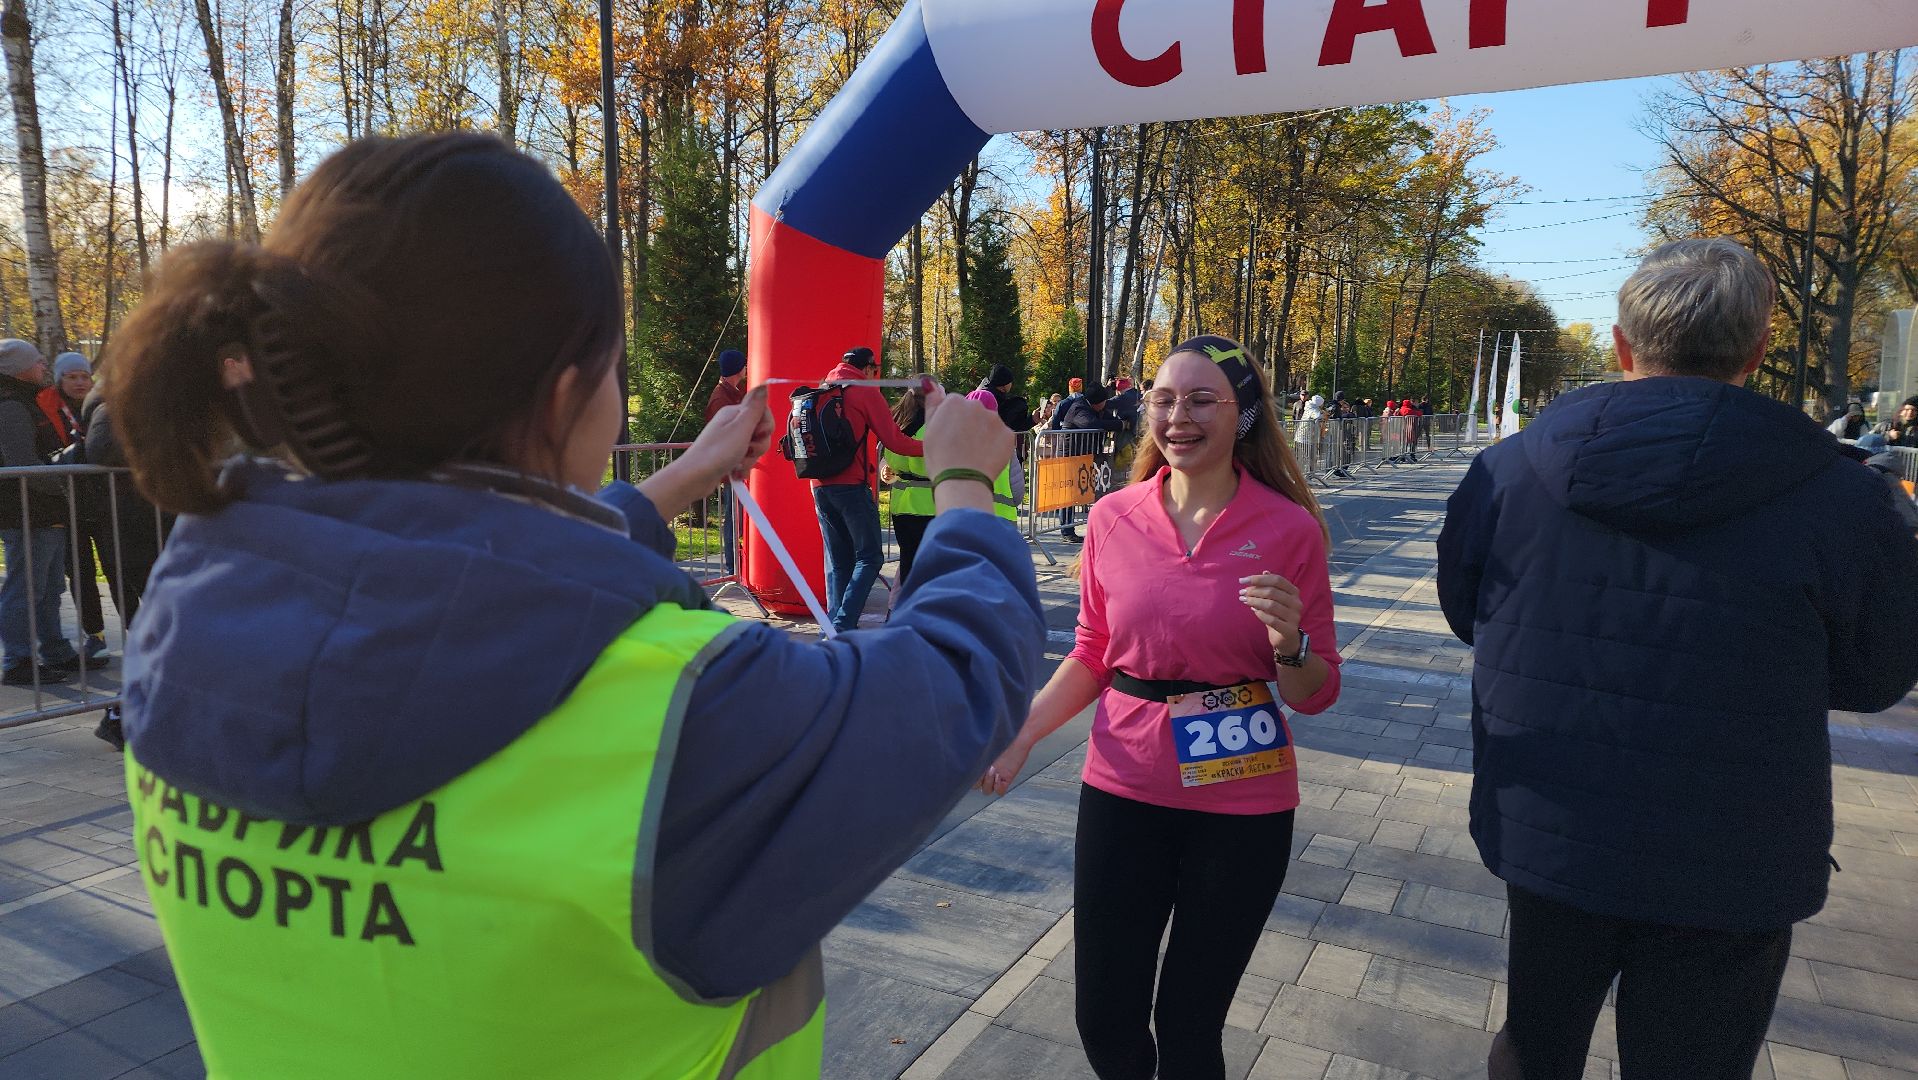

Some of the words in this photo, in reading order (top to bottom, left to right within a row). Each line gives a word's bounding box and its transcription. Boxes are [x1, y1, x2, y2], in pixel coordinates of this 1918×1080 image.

[1091, 0, 1689, 87] СТА
[1184, 710, 1277, 757] 260
[147, 826, 416, 947] СПОРТА
